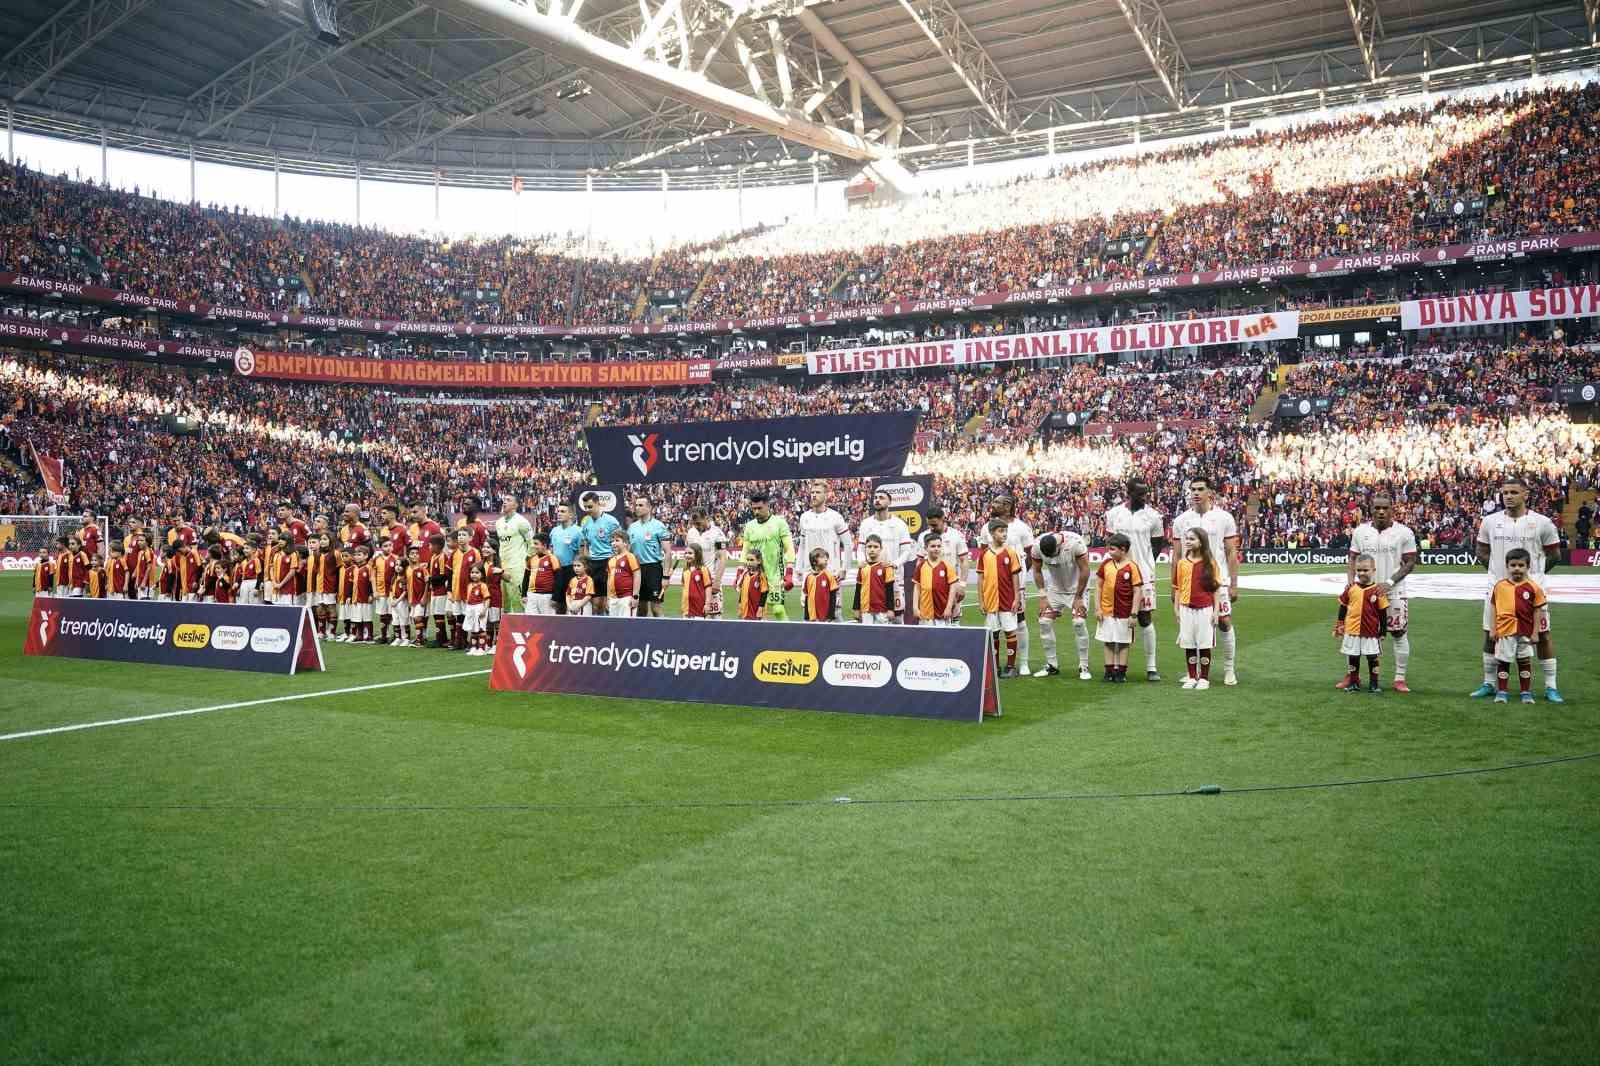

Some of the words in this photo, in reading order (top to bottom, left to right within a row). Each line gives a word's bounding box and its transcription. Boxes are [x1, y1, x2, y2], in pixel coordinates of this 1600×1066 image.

[1477, 242, 1517, 255] RAMS
[1521, 238, 1560, 251] PARK
[1344, 256, 1381, 269] RAMS
[1386, 252, 1420, 264] PARK
[1224, 268, 1258, 281] RAMS
[1261, 265, 1294, 277] PARK
[20, 277, 52, 290] RAMS
[55, 282, 83, 294] PARK
[1114, 280, 1145, 291] RAMS
[1149, 276, 1179, 288] PARK
[123, 293, 150, 305] RAMS
[152, 298, 178, 309] PARK
[1013, 291, 1042, 301] RAMS
[1046, 288, 1072, 299] PARK
[920, 301, 946, 311] RAMS
[949, 298, 975, 307] PARK
[215, 307, 243, 318] RAMS
[245, 311, 271, 321] PARK
[833, 309, 858, 320] RAMS
[860, 307, 884, 317] PARK
[308, 316, 336, 326] RAMS
[337, 319, 363, 329] PARK
[400, 323, 427, 332] RAMS
[429, 325, 455, 333] PARK
[667, 323, 692, 332] RAMS
[694, 321, 718, 331] PARK
[751, 318, 775, 328] RAMS
[19, 326, 48, 338] PARK
[491, 326, 519, 335] RAMS
[520, 326, 545, 334] PARK
[581, 326, 607, 335] RAMS
[608, 326, 633, 334] PARK
[1110, 319, 1240, 351] ÖLÜYOR!
[90, 336, 118, 346] RAMS
[121, 340, 147, 350] PARK
[185, 347, 212, 357] RAMS
[724, 360, 747, 369] RAMS
[750, 358, 773, 367] PARK
[662, 434, 769, 465] trendyol
[1246, 551, 1311, 565] trendyol
[1420, 551, 1480, 566] trendy
[768, 592, 779, 602] 35
[60, 617, 119, 641] trendyol
[548, 639, 651, 671] trendyol
[834, 659, 881, 671] trendyol
[841, 672, 872, 682] yemek
